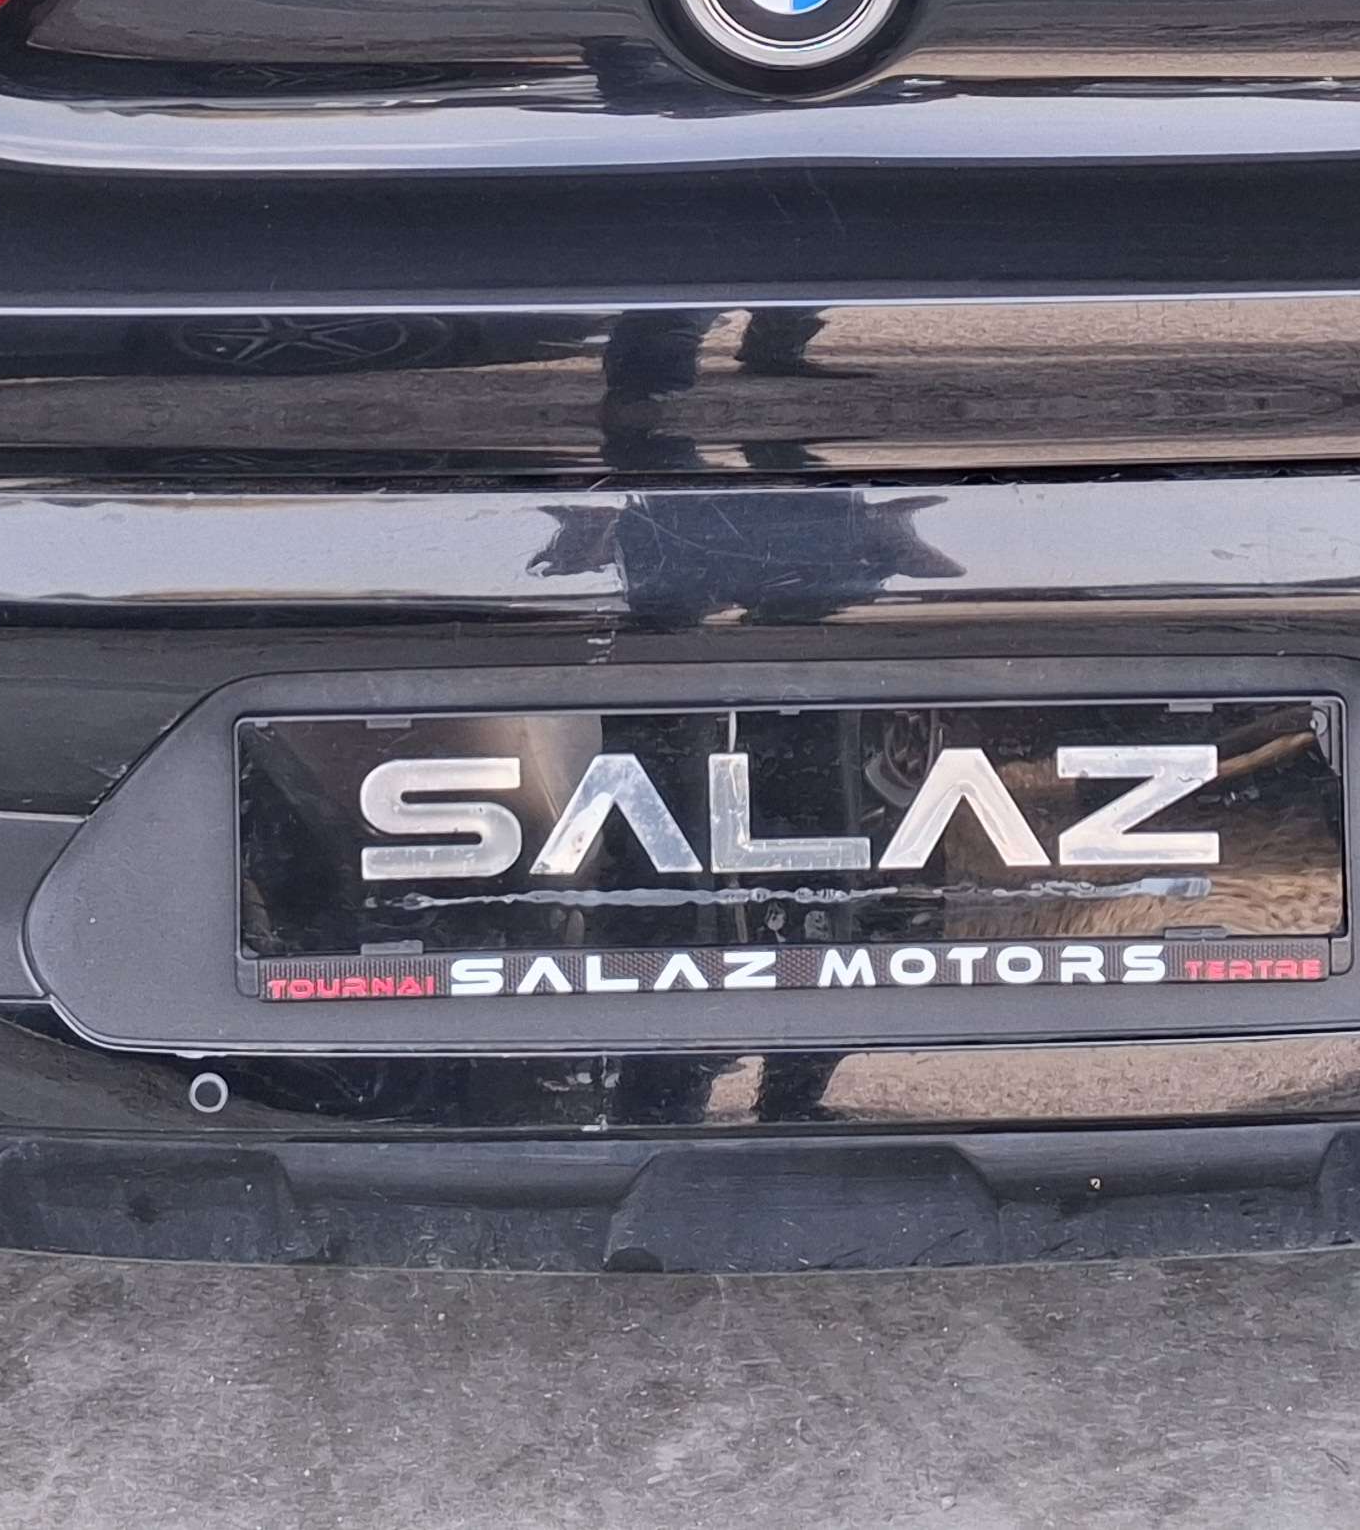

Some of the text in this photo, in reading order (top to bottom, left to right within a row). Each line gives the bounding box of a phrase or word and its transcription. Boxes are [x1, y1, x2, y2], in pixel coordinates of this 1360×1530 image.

[359, 744, 1220, 881] SALAZ
[266, 944, 1323, 1000] TOURNAI SALAZ MOTORS TERTRE
